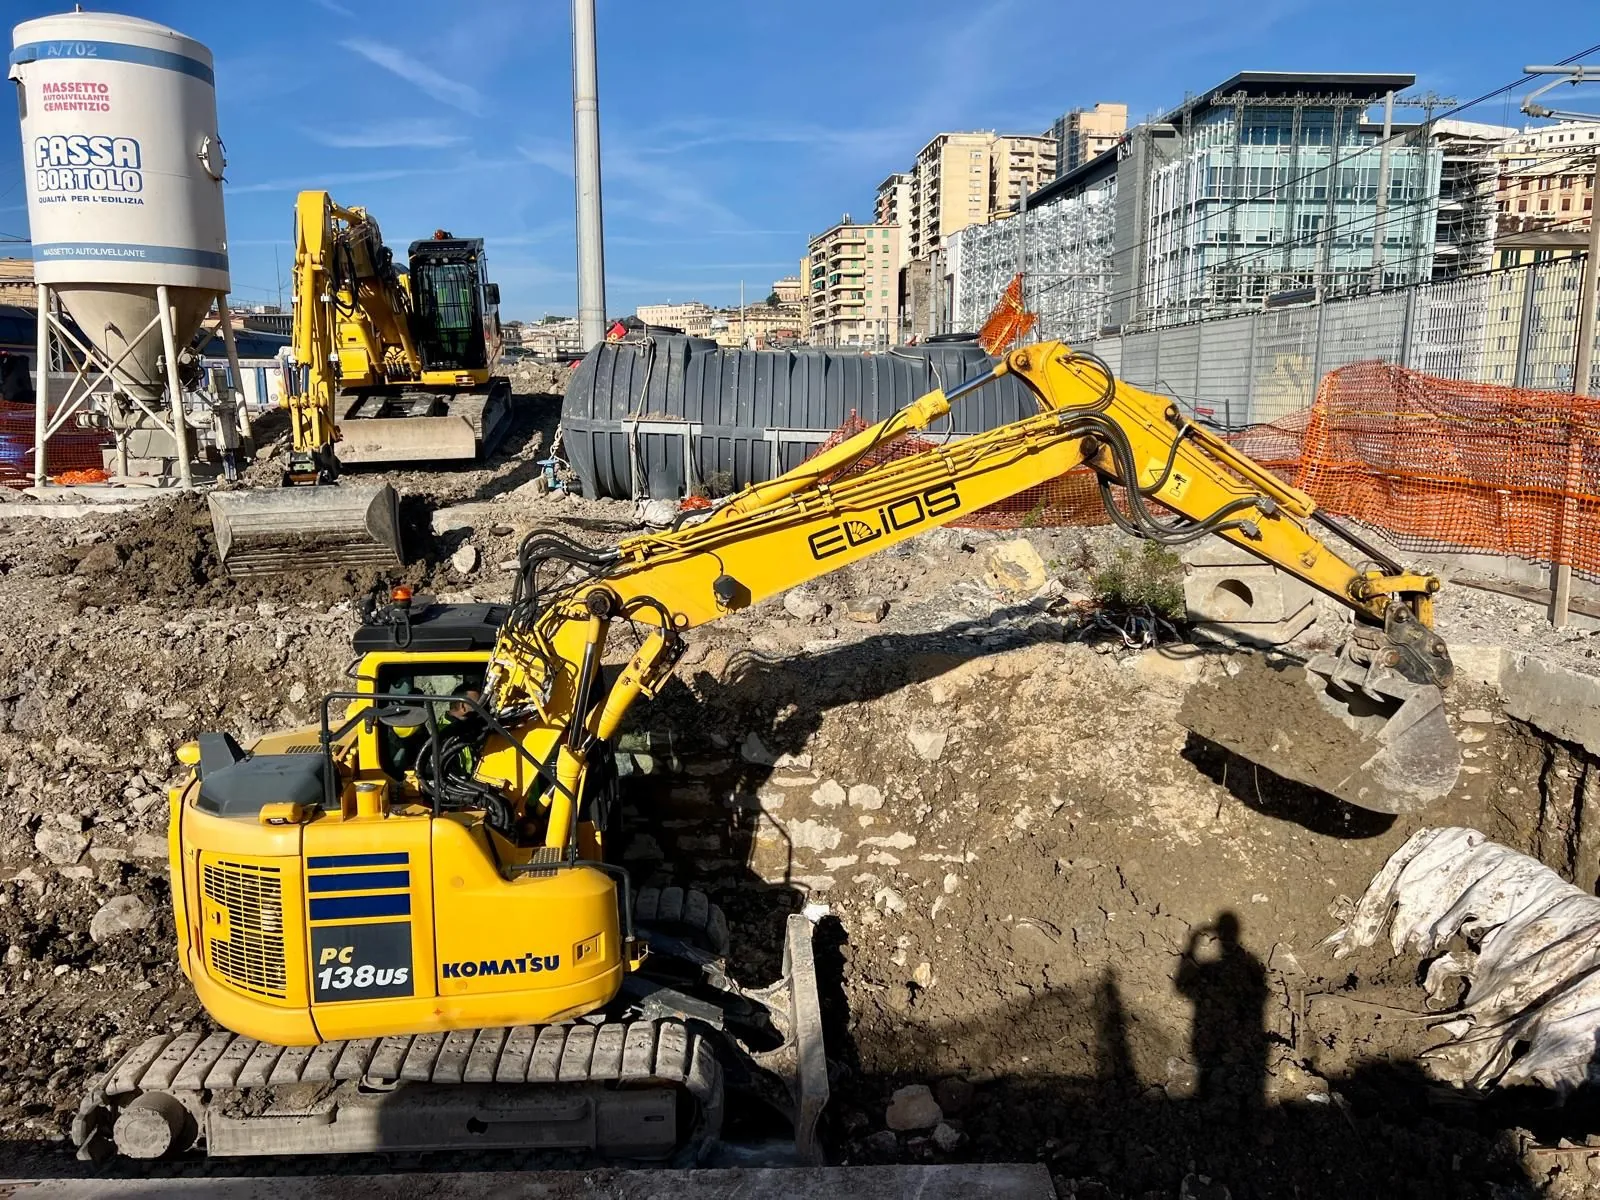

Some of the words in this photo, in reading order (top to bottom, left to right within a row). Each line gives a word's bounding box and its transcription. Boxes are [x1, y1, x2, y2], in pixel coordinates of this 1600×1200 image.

[47, 42, 97, 57] A/702
[42, 82, 109, 94] MASSETTO
[43, 93, 110, 102] AUTOLIVELLANTE
[43, 101, 110, 112] CEMENTIZIO
[35, 135, 141, 169] FASSA
[37, 168, 143, 192] BORTOLO
[92, 195, 144, 205] L'EDILIZIA
[43, 247, 74, 256] MASSETTO
[75, 247, 146, 258] AUTOLIVELLANTE
[319, 946, 354, 965] PC
[442, 952, 560, 979] KOMATSU
